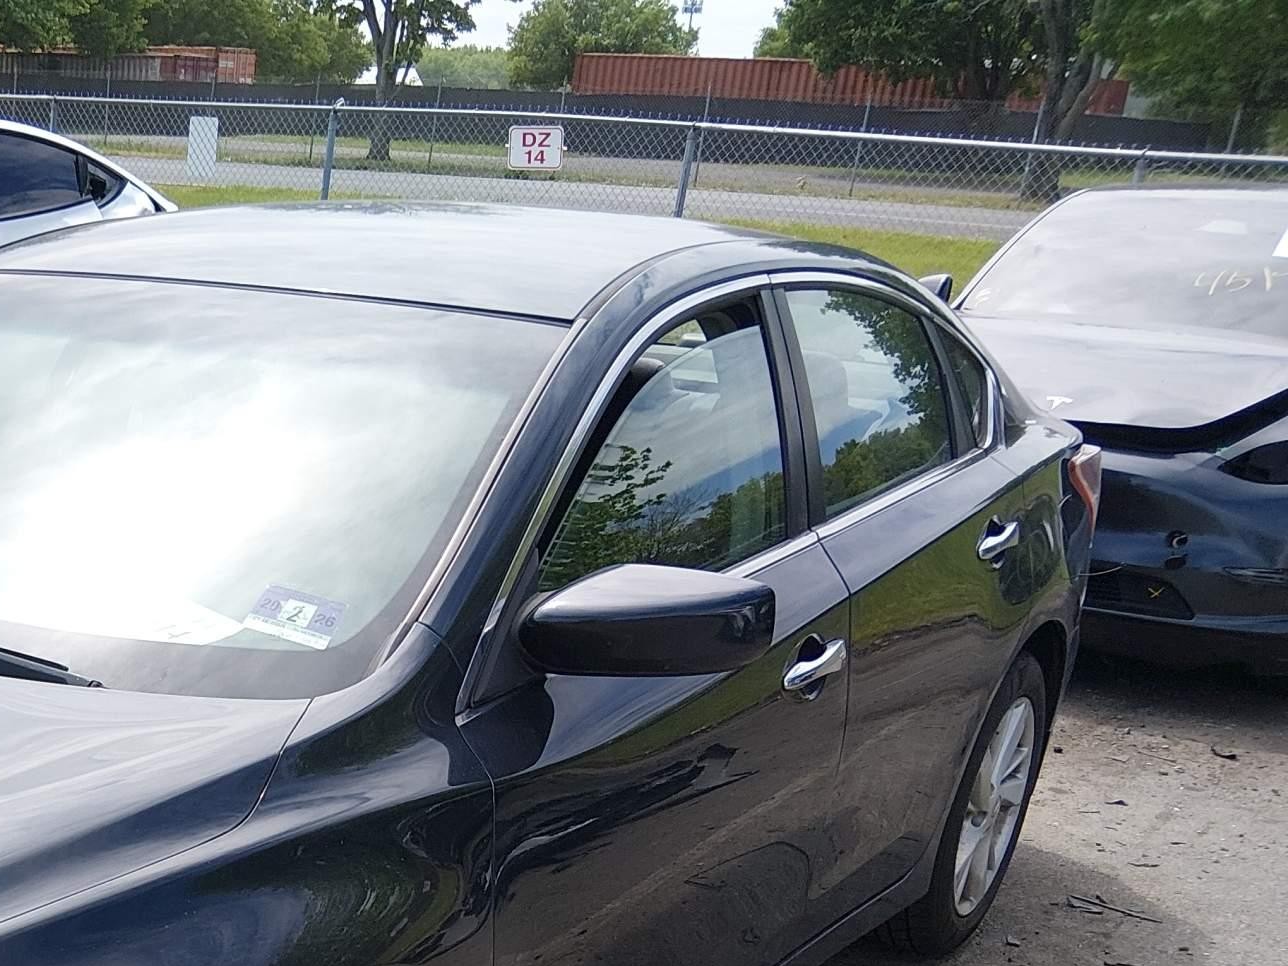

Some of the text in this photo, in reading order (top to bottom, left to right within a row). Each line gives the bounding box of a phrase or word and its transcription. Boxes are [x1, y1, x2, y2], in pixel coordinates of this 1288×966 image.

[521, 131, 552, 148] DZ
[524, 149, 547, 165] 14
[260, 598, 281, 612] 20
[286, 605, 306, 623] 2
[314, 613, 338, 628] 26
